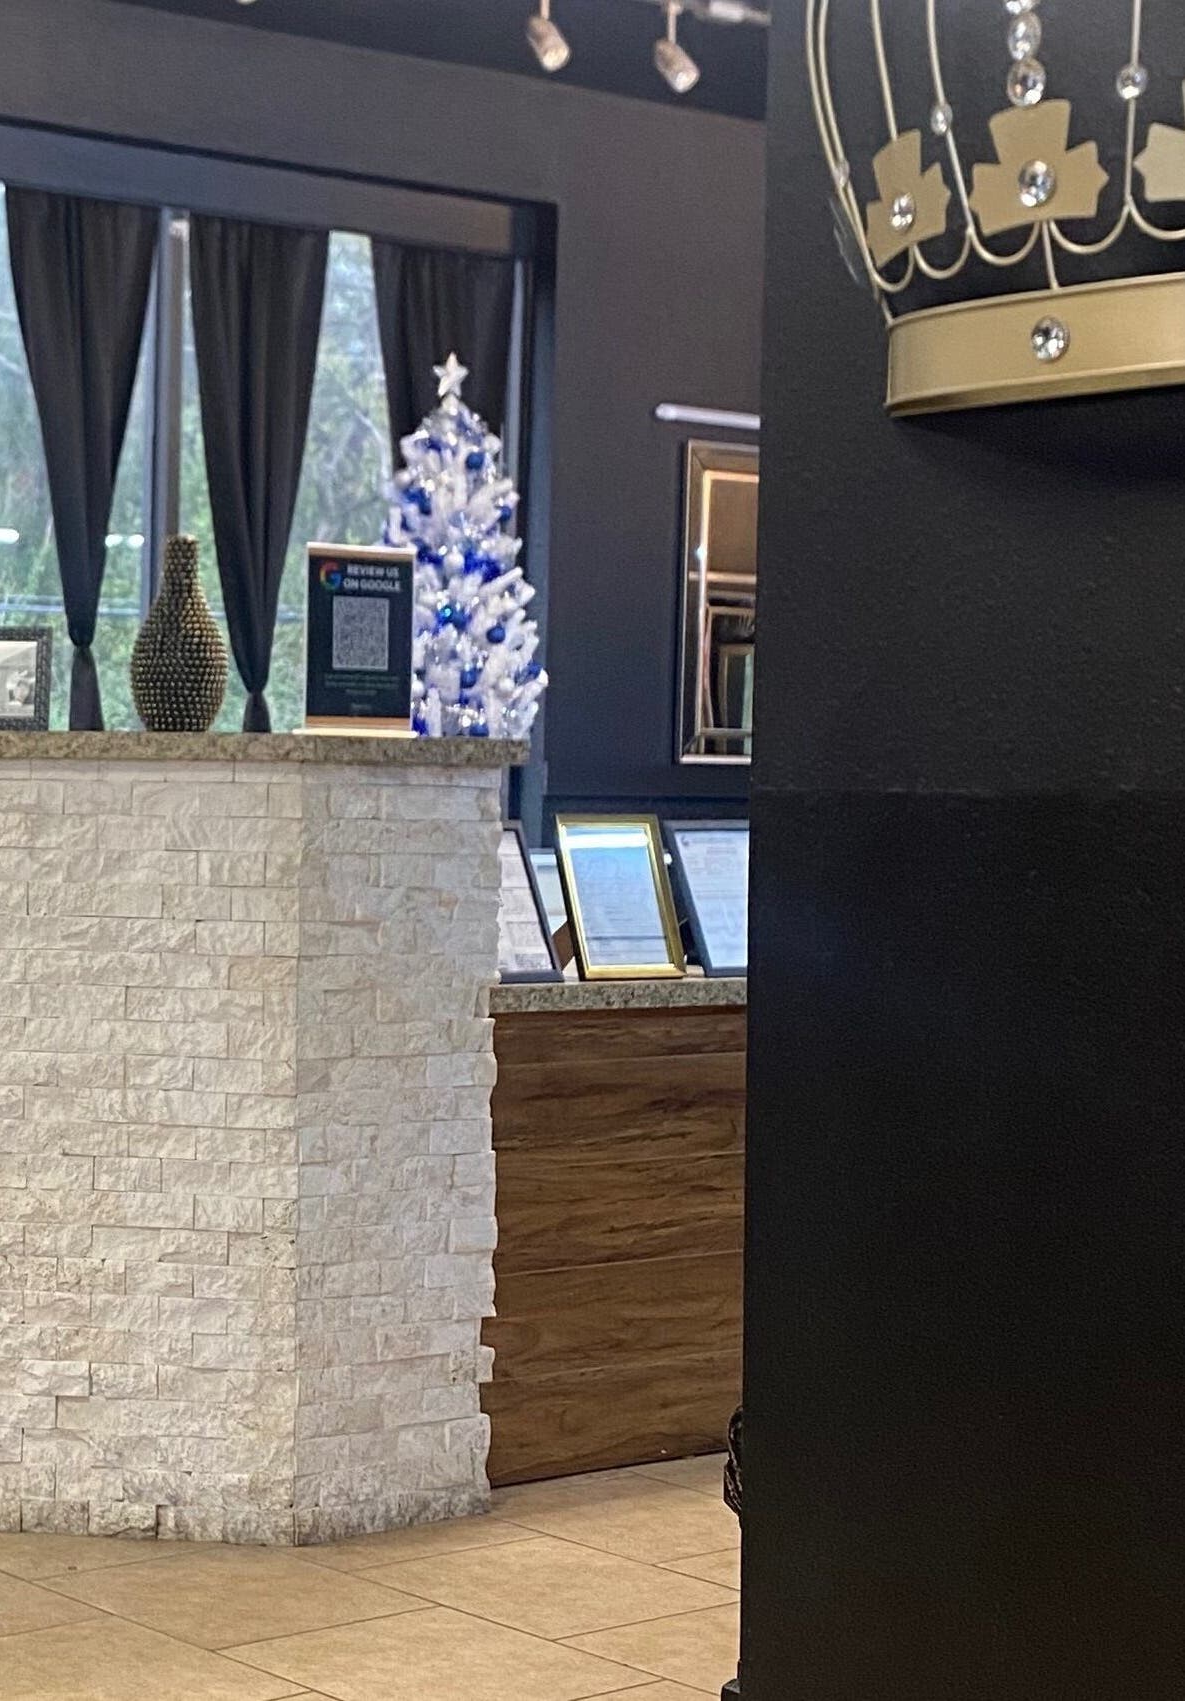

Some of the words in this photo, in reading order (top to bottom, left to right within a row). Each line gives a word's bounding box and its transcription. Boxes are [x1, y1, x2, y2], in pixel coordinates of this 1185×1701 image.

[346, 563, 384, 577] REVIEW
[386, 566, 399, 578] US
[343, 578, 359, 590] ON
[360, 578, 400, 592] GOOGLE
